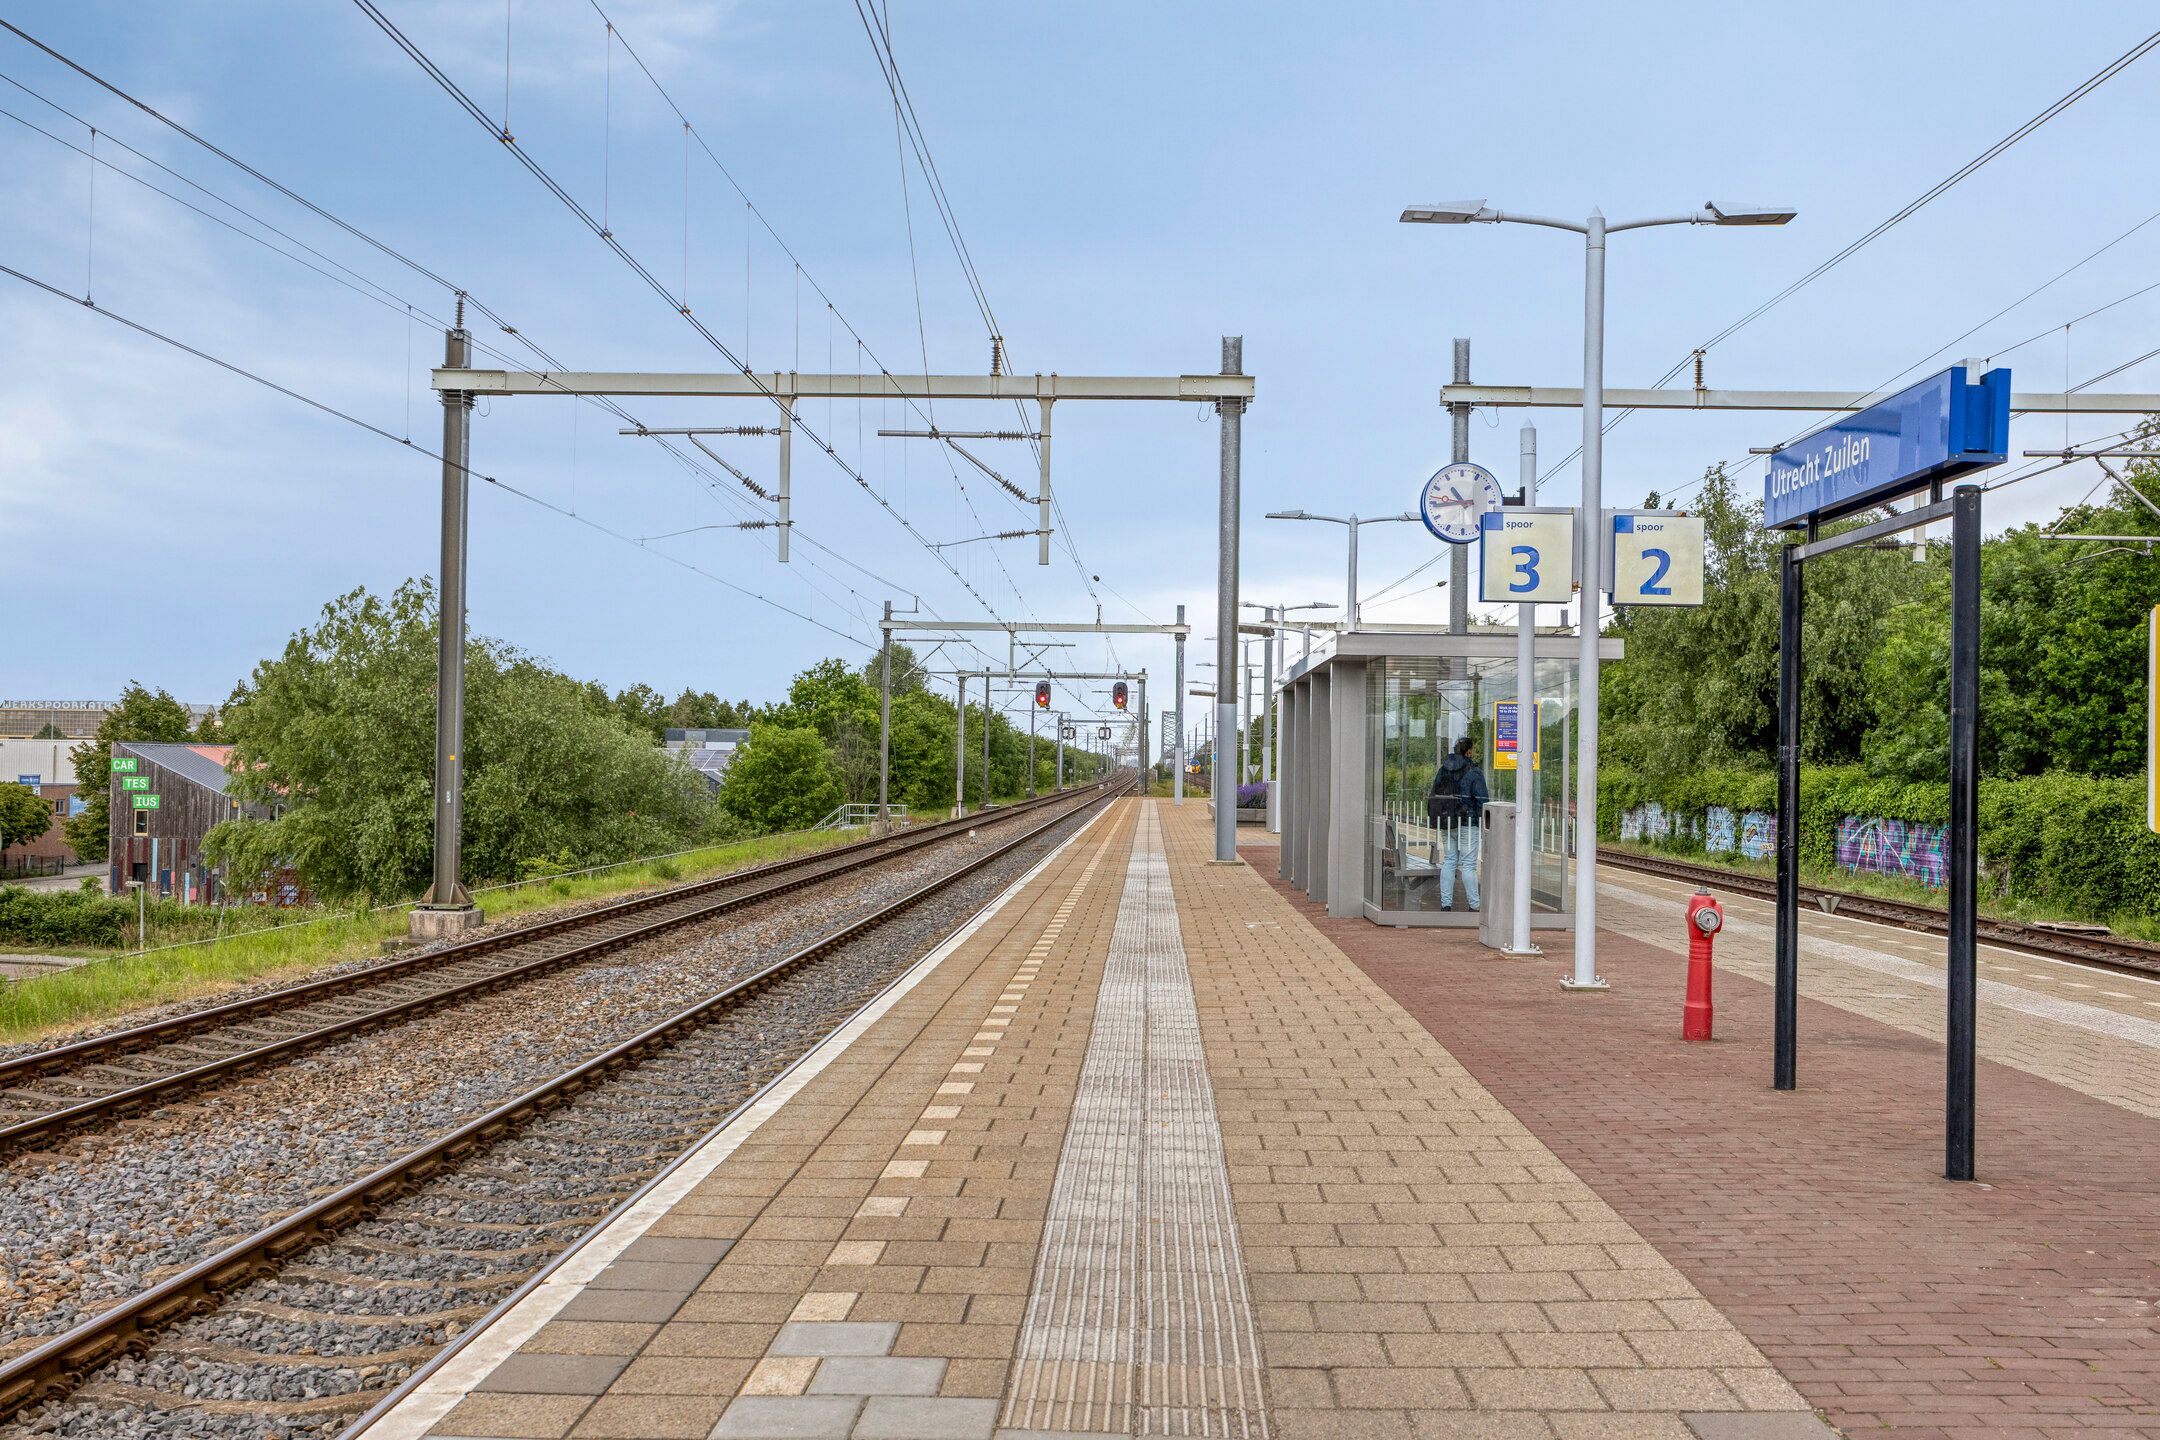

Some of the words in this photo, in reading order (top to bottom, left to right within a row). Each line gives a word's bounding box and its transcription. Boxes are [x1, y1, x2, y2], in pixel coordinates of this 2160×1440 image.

[1772, 453, 1820, 499] Utrecht
[1824, 434, 1870, 478] Zuilen
[1506, 520, 1534, 529] spoor
[1636, 523, 1664, 532] spoor
[1509, 545, 1541, 593] 3
[1639, 548, 1672, 596] 2
[113, 761, 134, 770] CAR
[125, 779, 147, 788] TES
[136, 797, 157, 806] IUS
